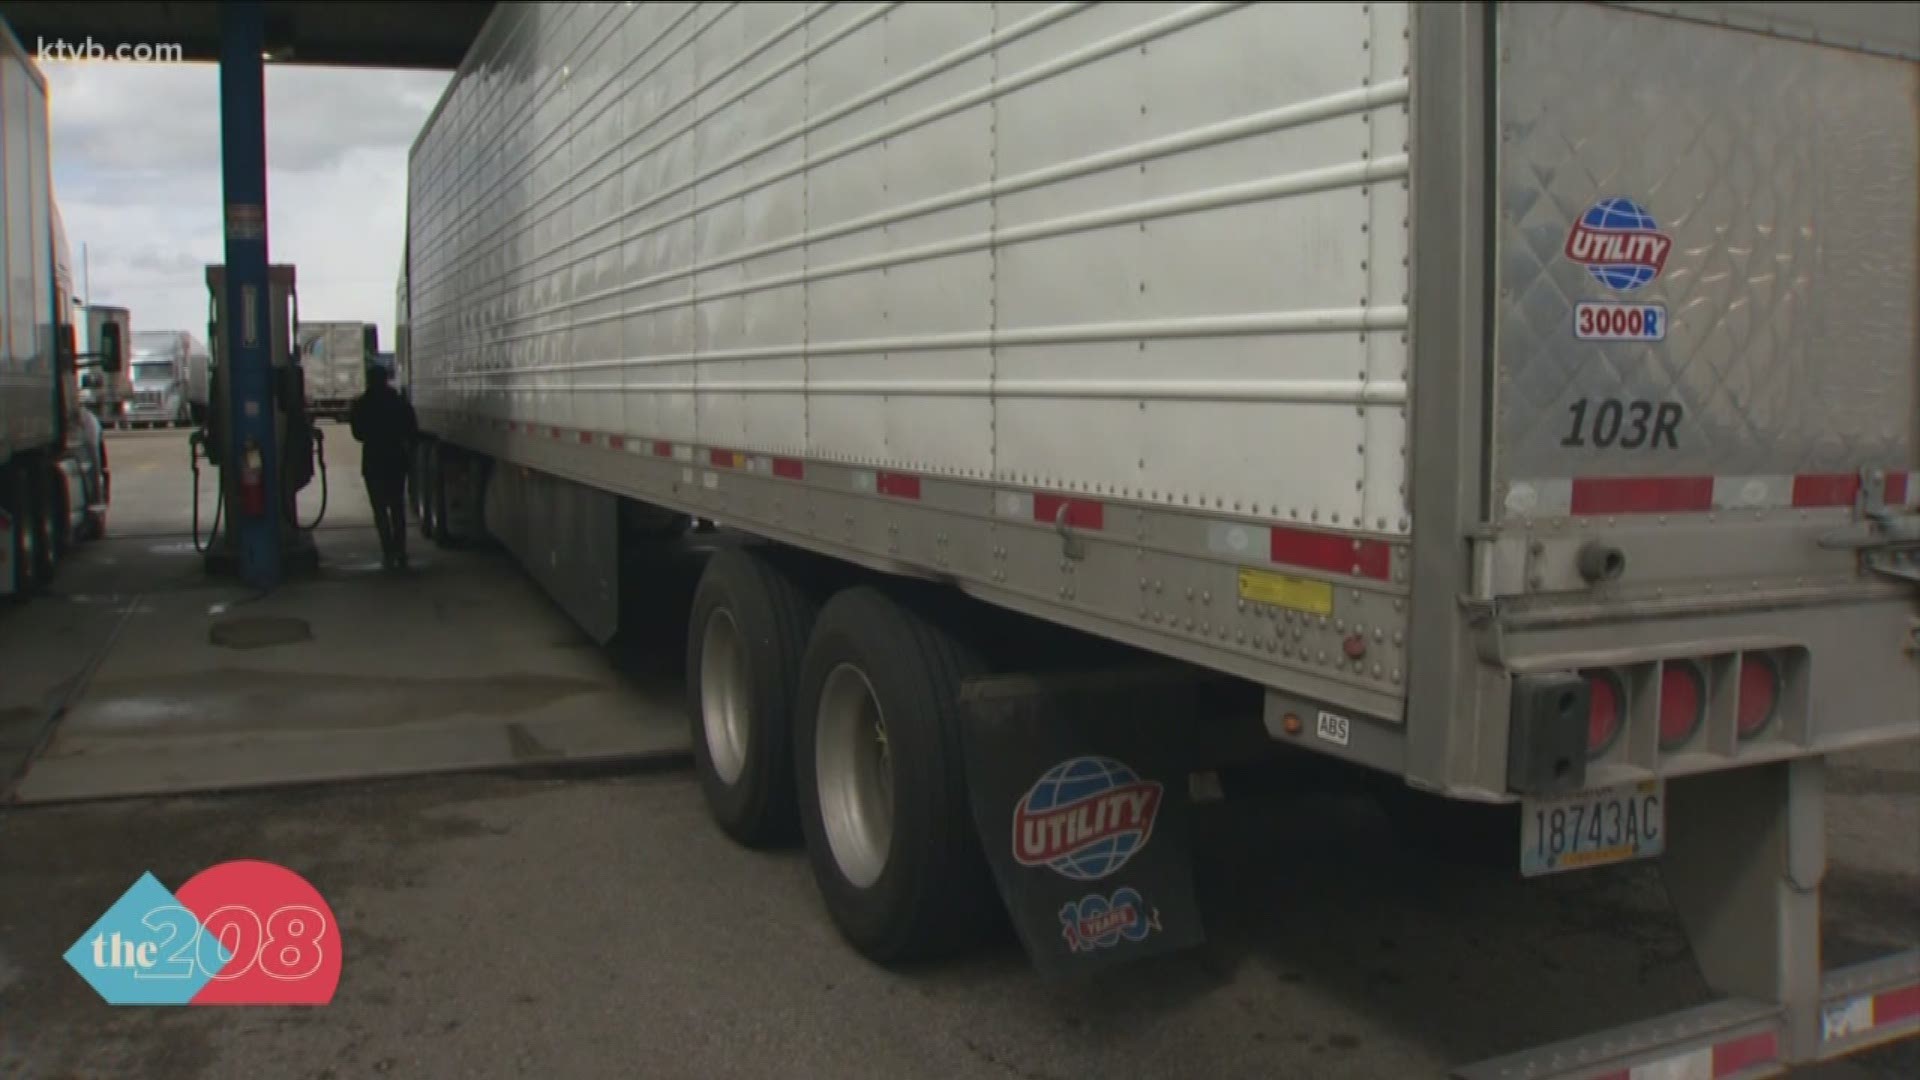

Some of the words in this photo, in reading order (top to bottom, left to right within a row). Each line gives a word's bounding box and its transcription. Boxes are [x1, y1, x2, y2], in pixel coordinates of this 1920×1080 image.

[1571, 231, 1667, 264] UTILITY
[1580, 307, 1658, 336] 3000R
[1560, 398, 1683, 450] 103R
[1320, 714, 1348, 740] ABS
[1023, 791, 1152, 855] UTILITY
[1536, 796, 1658, 859] 18743AC
